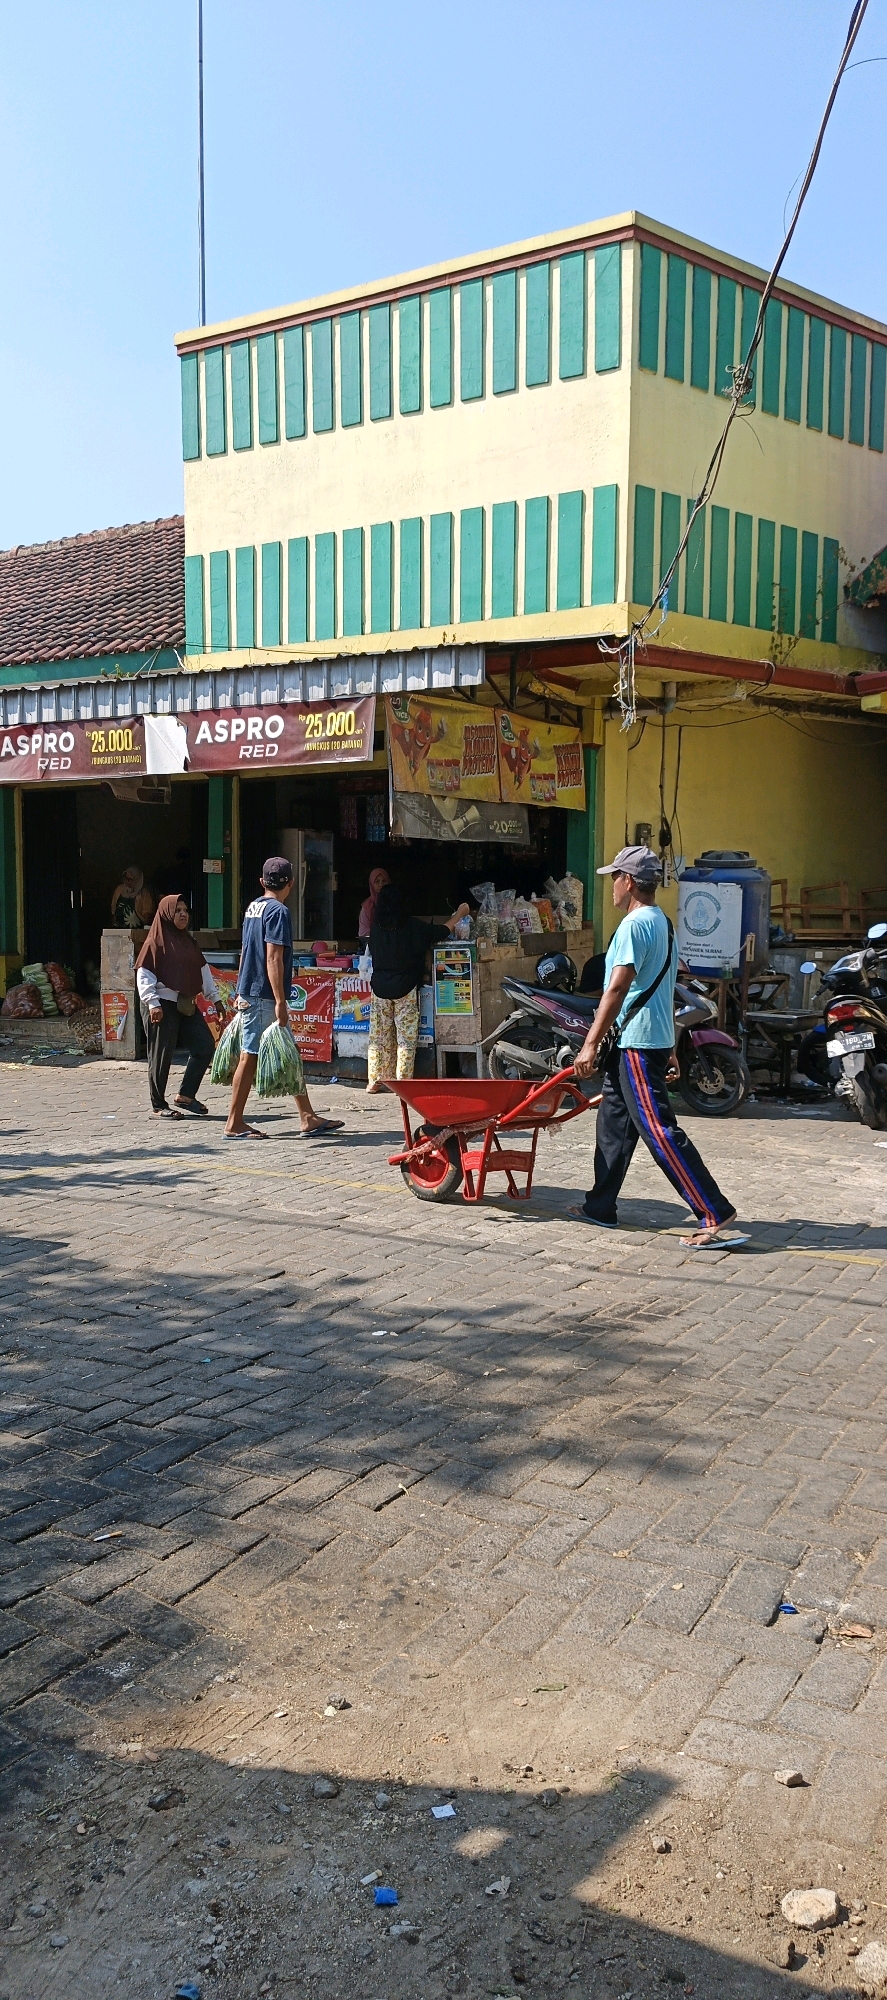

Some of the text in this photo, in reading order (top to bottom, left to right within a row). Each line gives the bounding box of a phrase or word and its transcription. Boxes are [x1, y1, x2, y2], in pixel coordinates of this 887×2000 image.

[298, 714, 306, 722] Rp
[195, 714, 285, 745] ASPRO
[0, 731, 75, 757] ASPRO
[239, 743, 279, 759] RED
[303, 738, 363, 752] /BUNGKUS (20 BATANG)
[37, 757, 72, 771] RED
[122, 754, 142, 764] BATANG)
[341, 976, 371, 993] GRATI
[288, 1014, 331, 1025] AN REFILL
[303, 1024, 317, 1034] PCS
